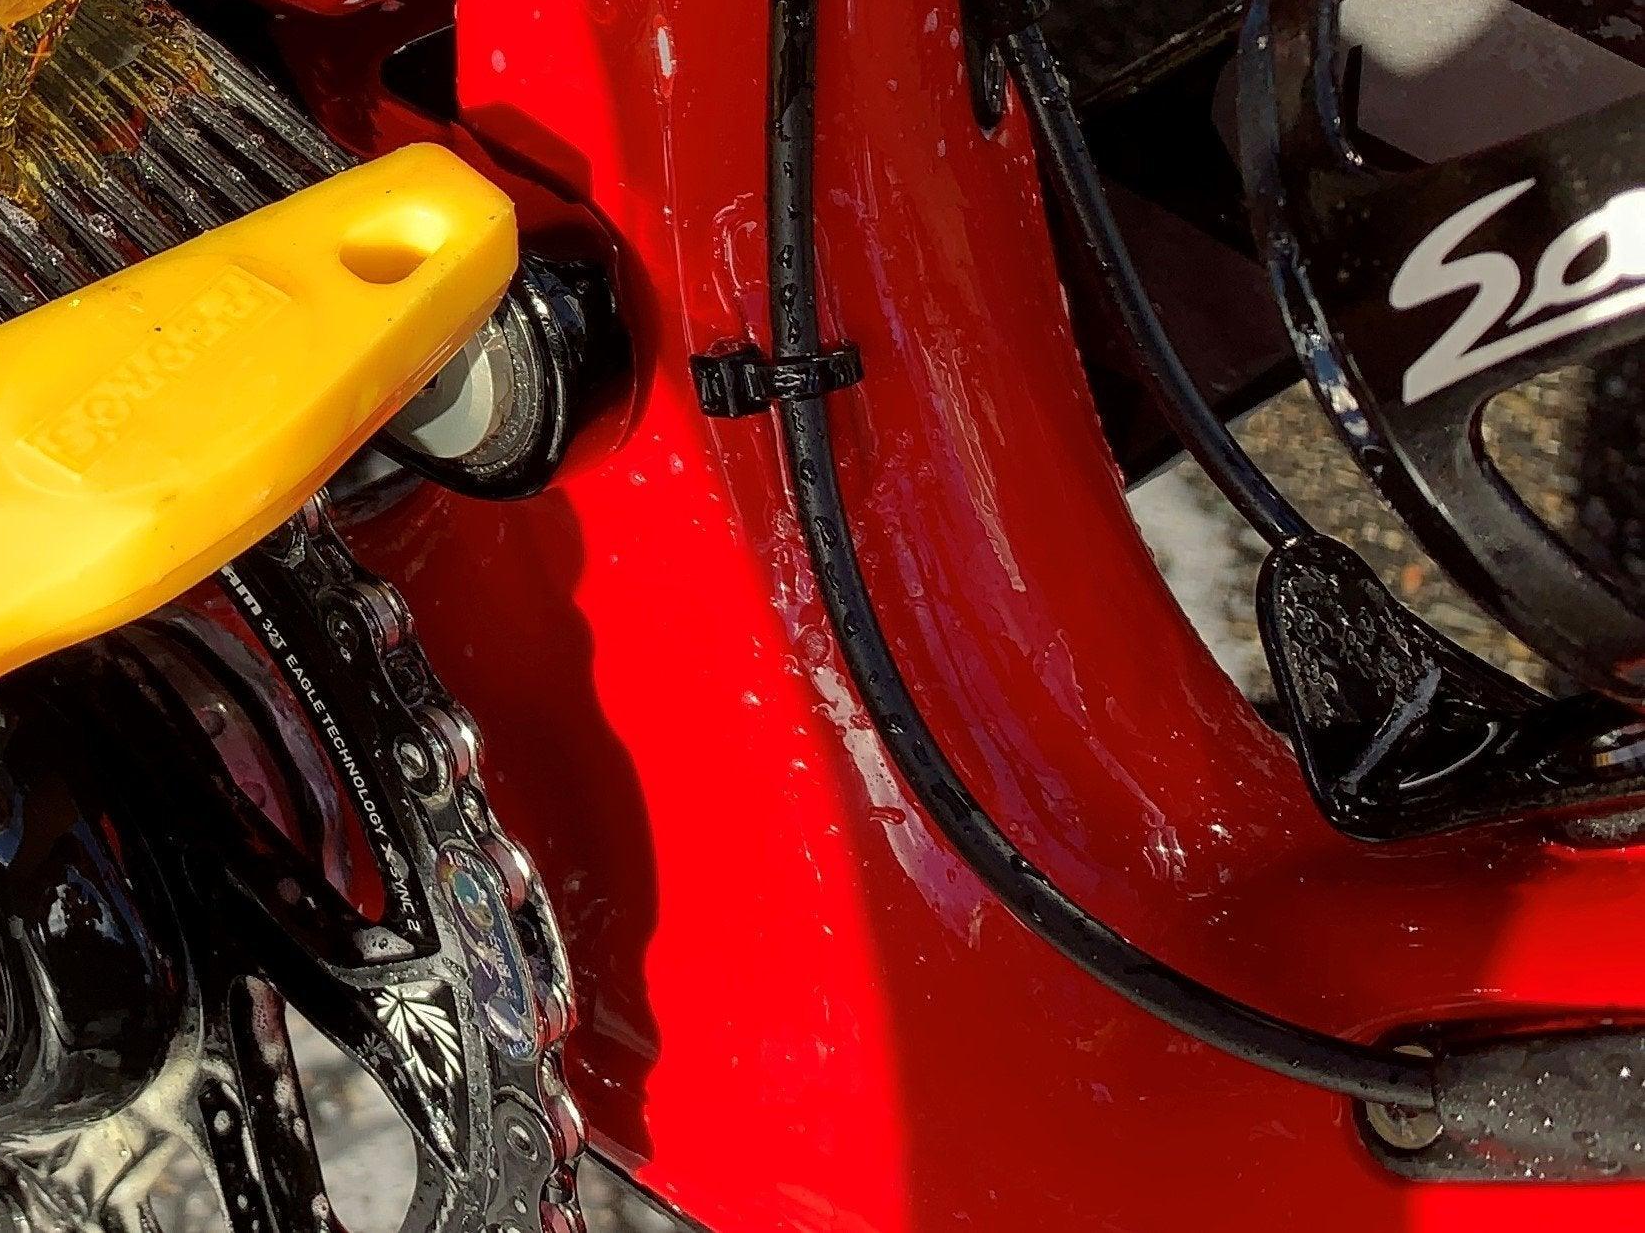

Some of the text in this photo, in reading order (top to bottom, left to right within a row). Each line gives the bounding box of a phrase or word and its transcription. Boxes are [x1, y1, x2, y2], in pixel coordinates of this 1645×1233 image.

[262, 618, 288, 650] 32T
[285, 653, 326, 714] EAGLE
[322, 712, 388, 837] TECHNOLOGY
[406, 918, 421, 932] 2
